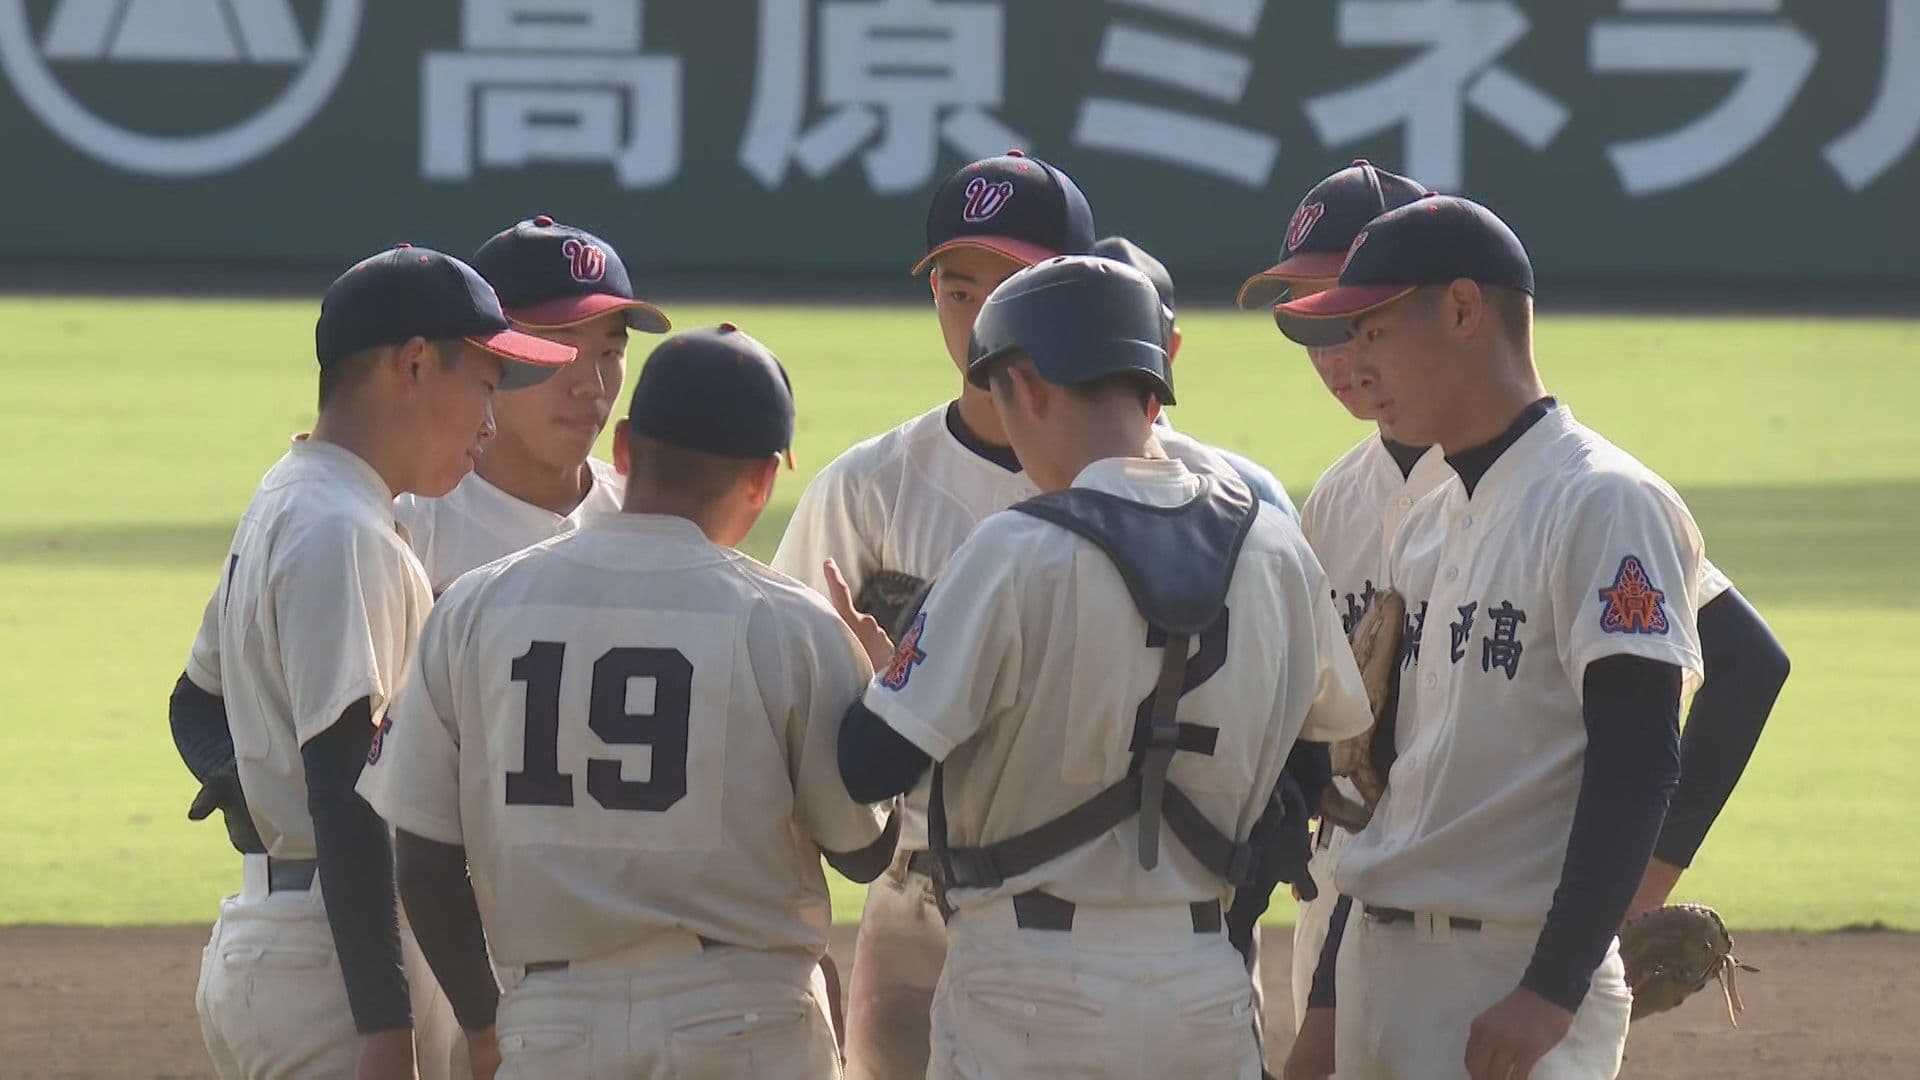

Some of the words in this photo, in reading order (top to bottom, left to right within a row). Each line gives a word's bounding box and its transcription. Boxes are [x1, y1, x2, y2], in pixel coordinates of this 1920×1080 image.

[964, 177, 1014, 222] W
[562, 239, 606, 283] W
[505, 640, 694, 812] 19
